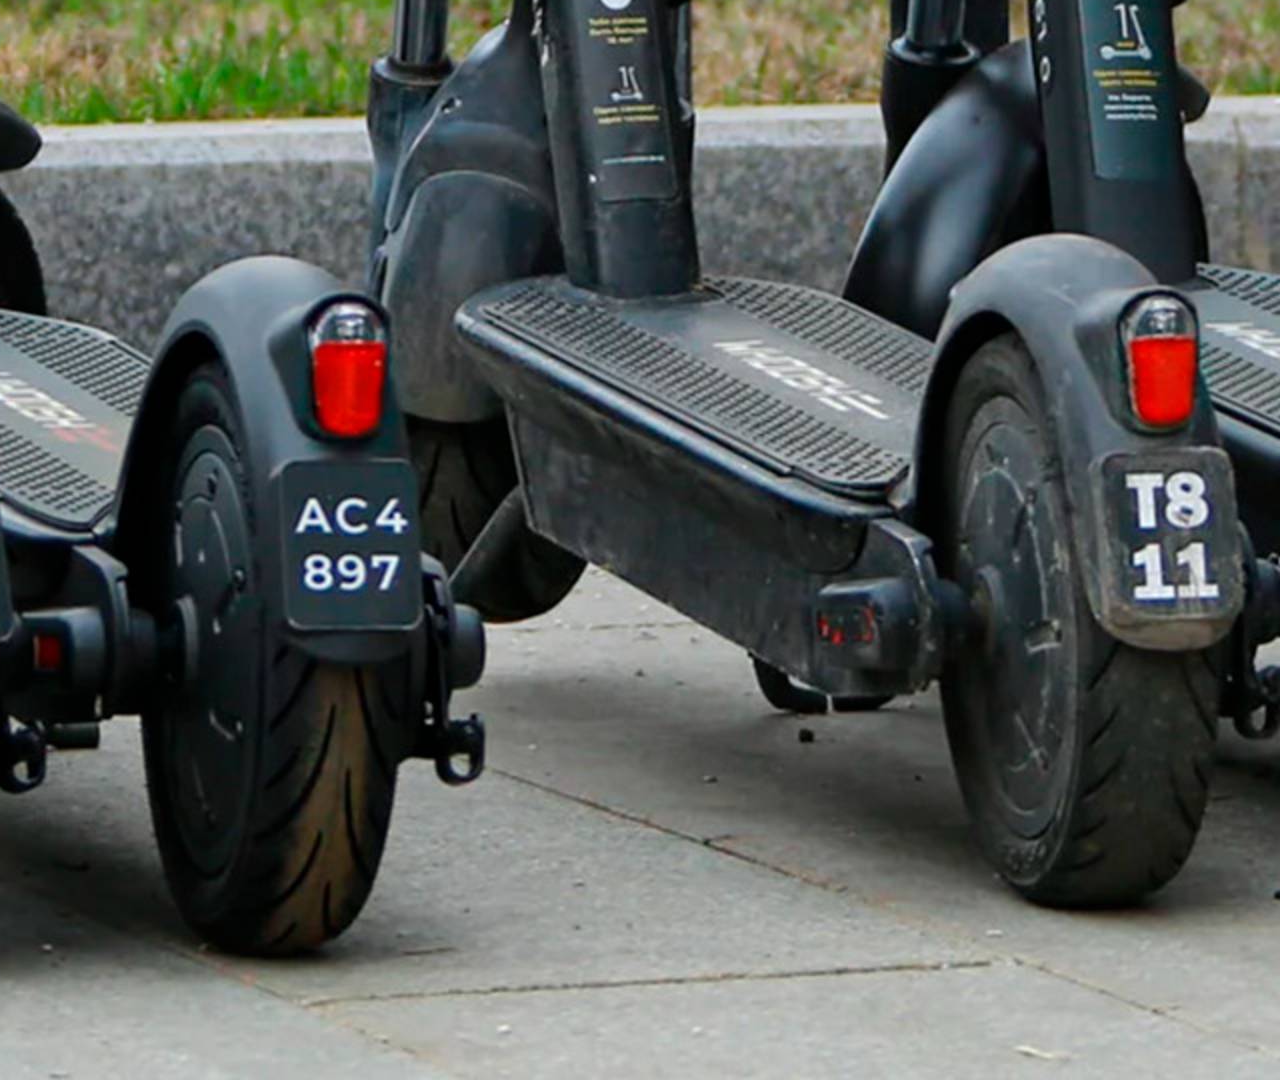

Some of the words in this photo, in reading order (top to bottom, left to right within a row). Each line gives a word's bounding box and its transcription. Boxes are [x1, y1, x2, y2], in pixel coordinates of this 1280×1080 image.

[294, 497, 409, 534] AC4
[1125, 471, 1210, 529] T8
[303, 554, 401, 591] 897
[1132, 542, 1220, 600] 11
